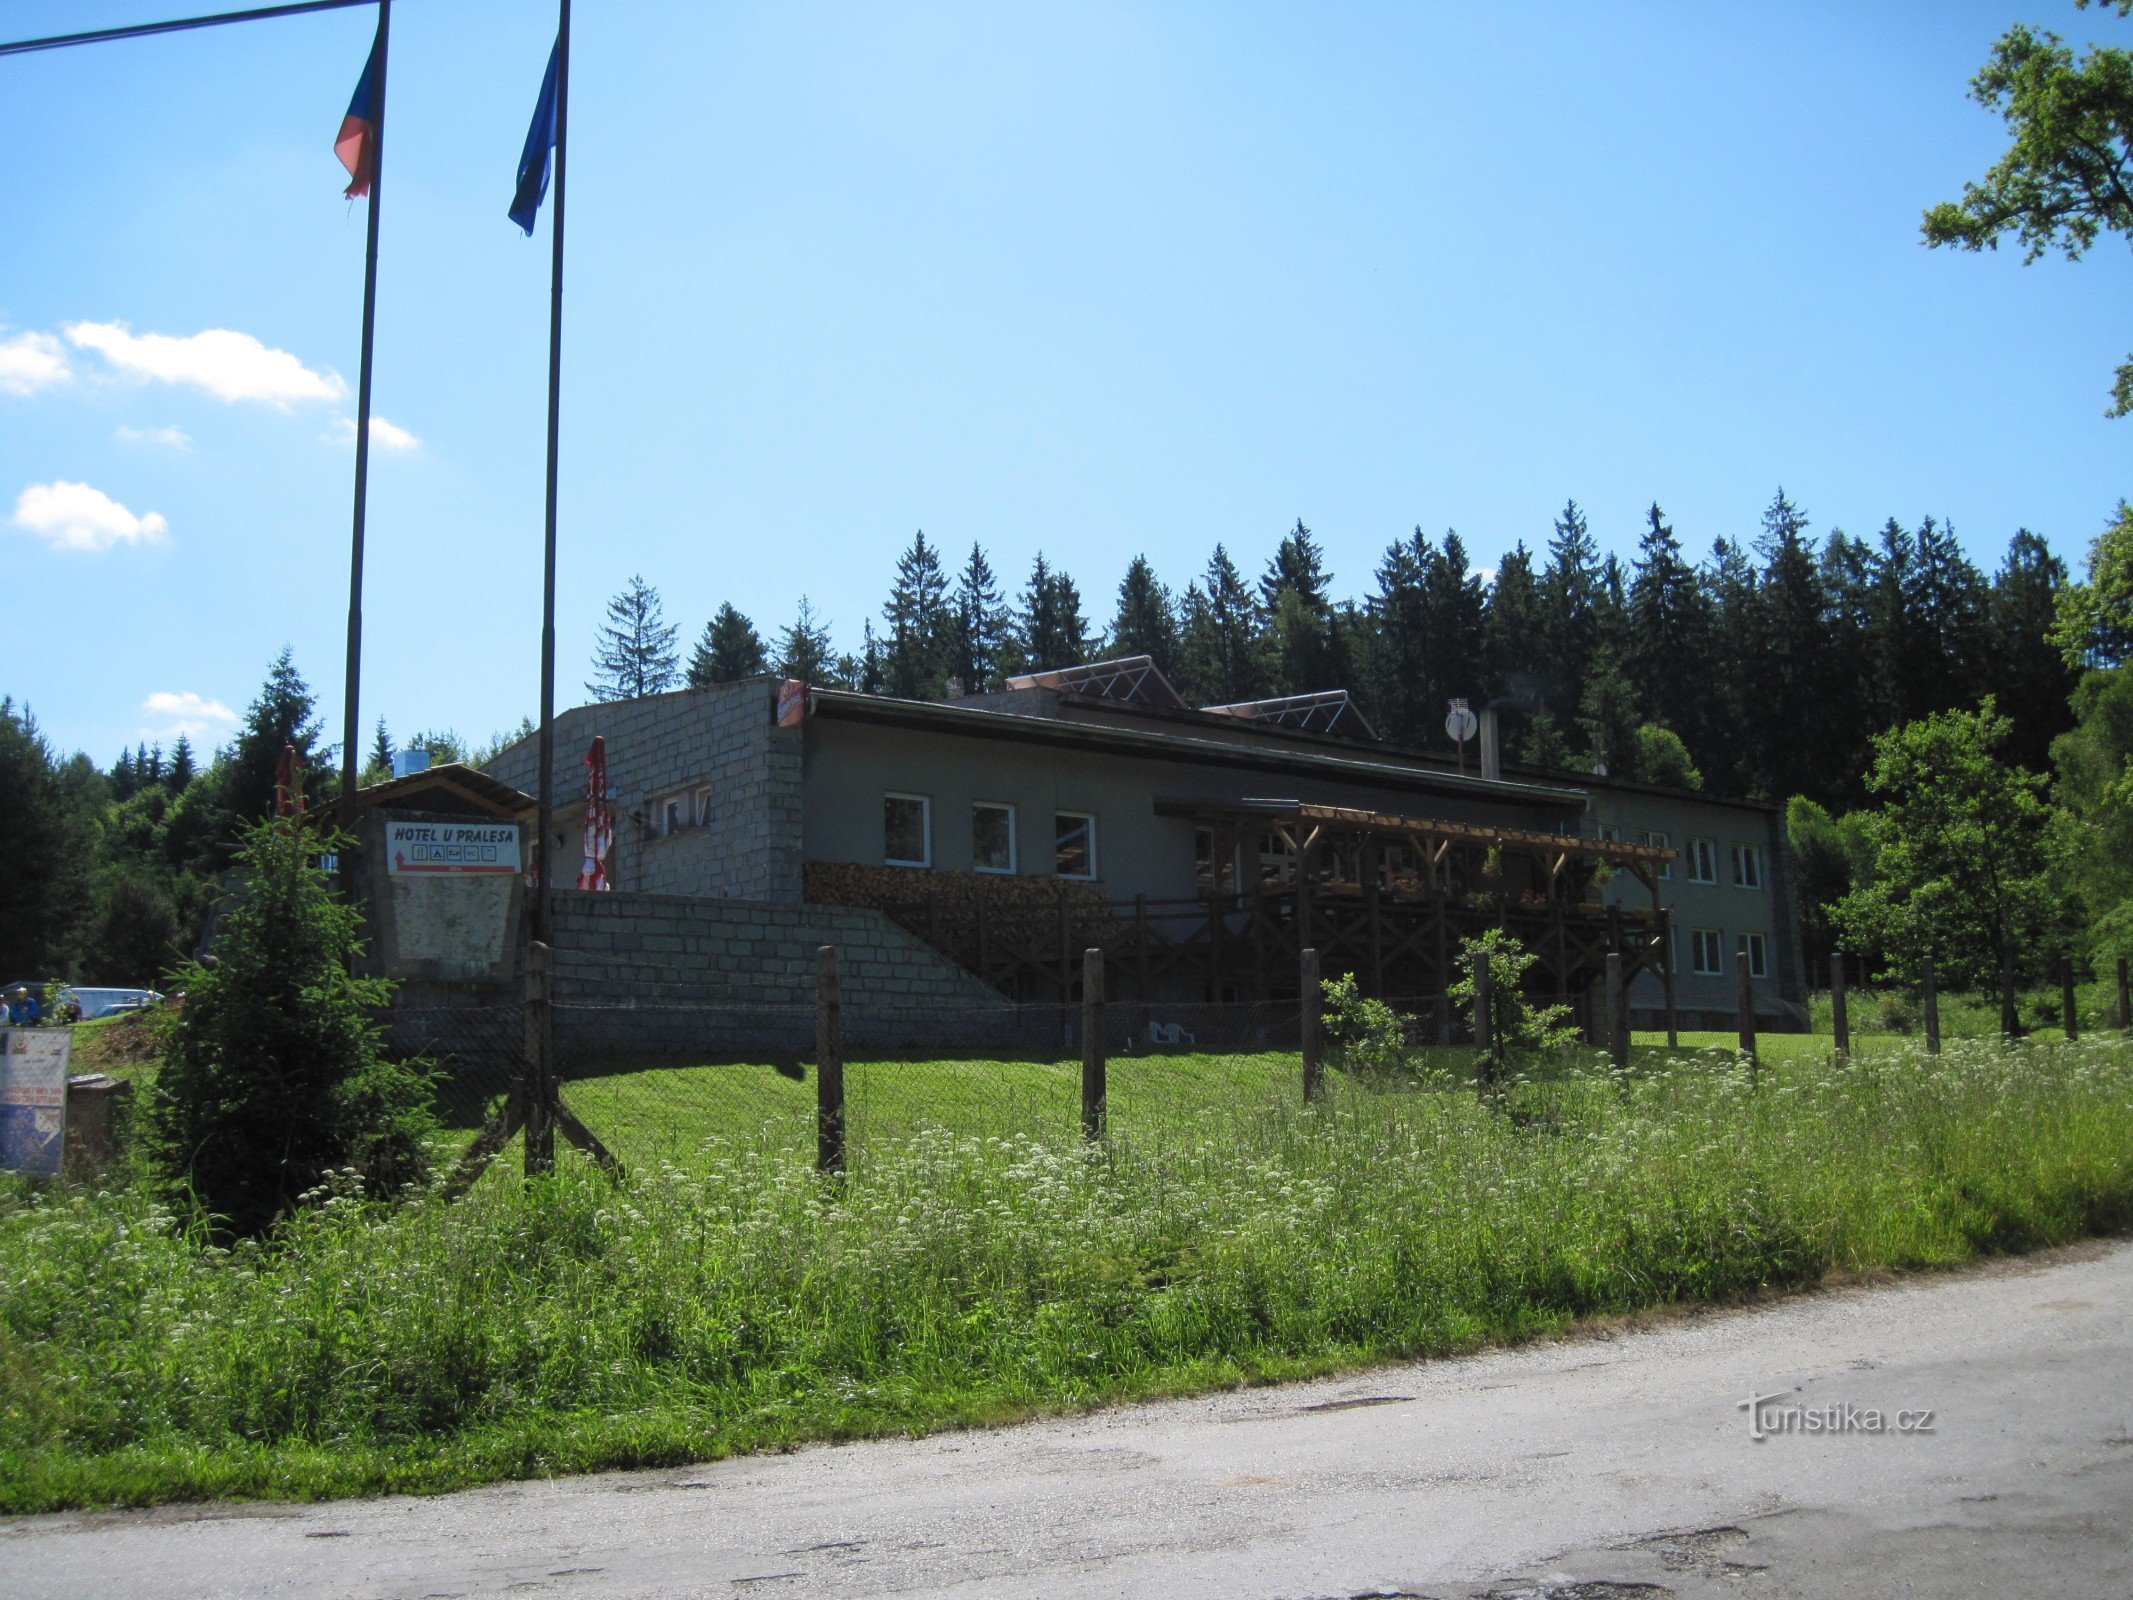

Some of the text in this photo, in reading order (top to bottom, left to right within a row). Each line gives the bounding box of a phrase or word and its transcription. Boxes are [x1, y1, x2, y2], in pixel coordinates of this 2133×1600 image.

[395, 828, 513, 843] HOTEL U PRALESA
